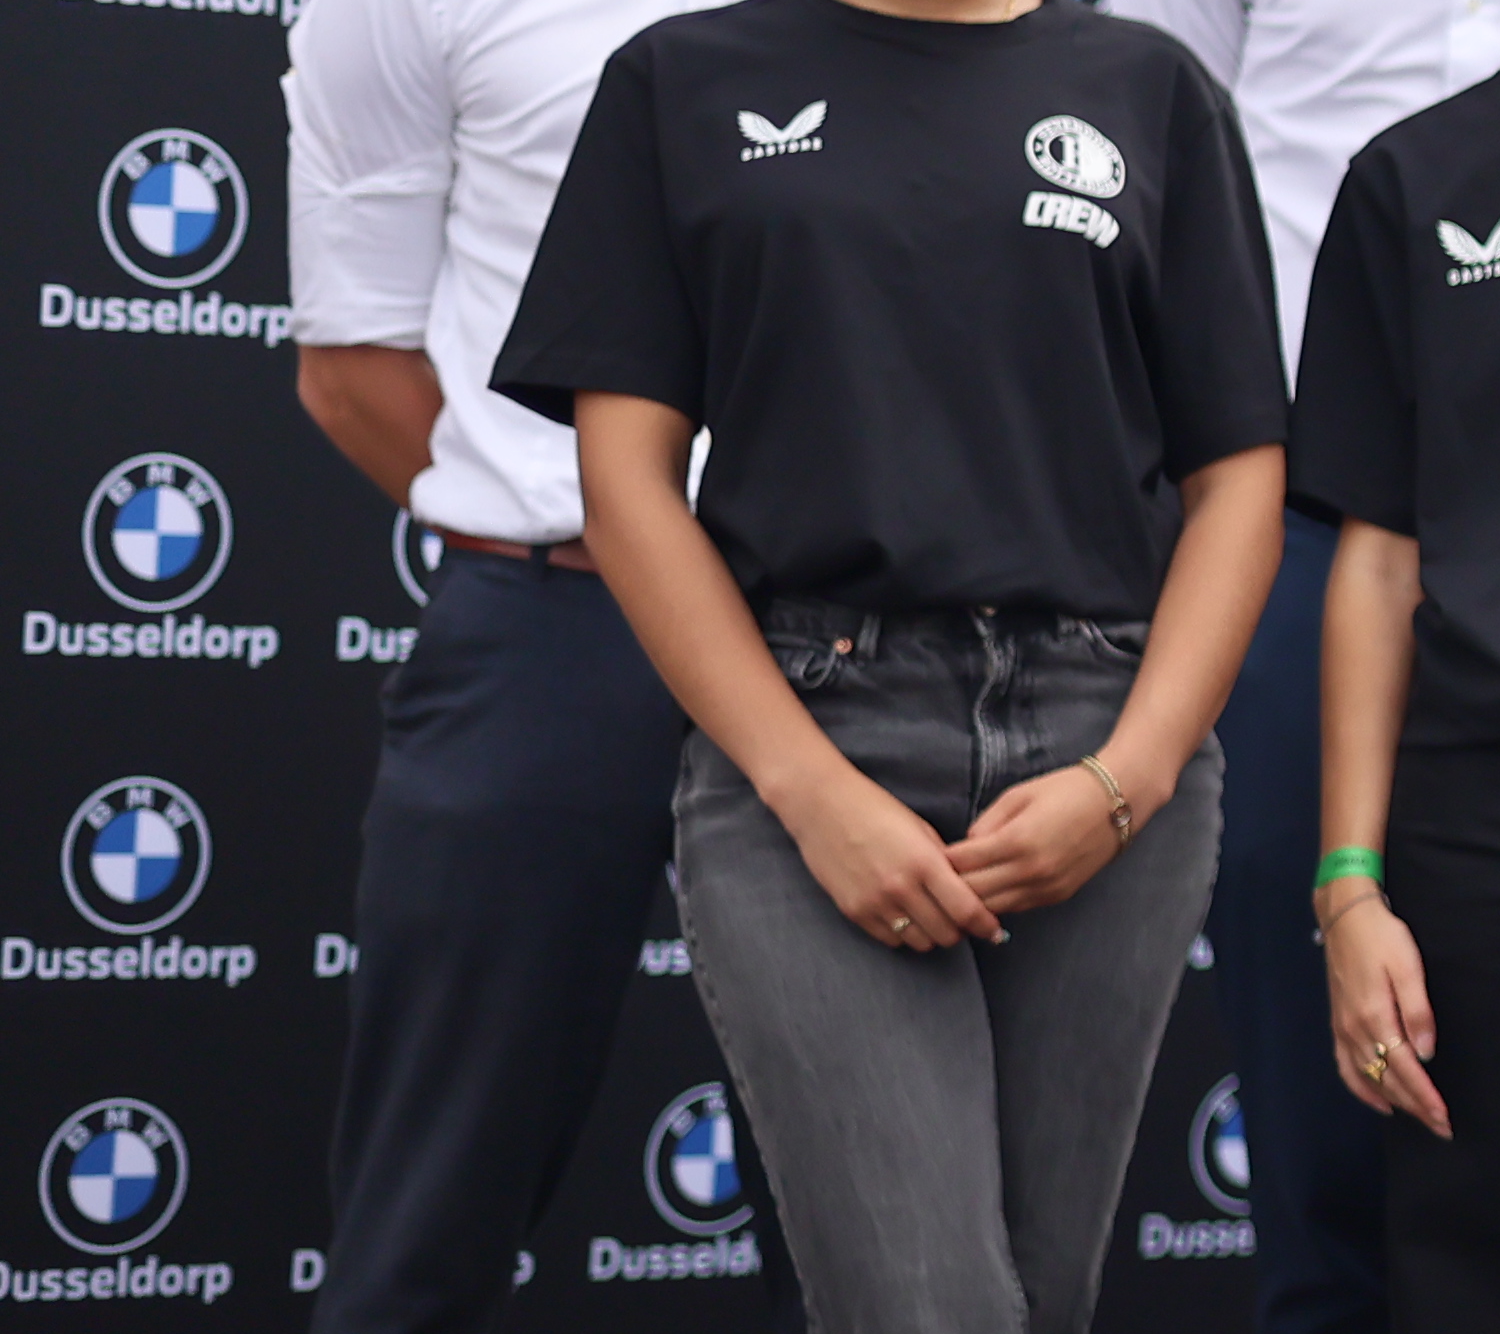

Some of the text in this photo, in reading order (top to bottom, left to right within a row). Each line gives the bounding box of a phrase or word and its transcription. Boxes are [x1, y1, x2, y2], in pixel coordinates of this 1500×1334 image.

[1022, 190, 1120, 249] CREW
[40, 284, 290, 345] Dusseldorp
[22, 611, 279, 666] Dusseldorp
[1, 934, 258, 987] Dusseldorp
[589, 1234, 762, 1279] Dusseld
